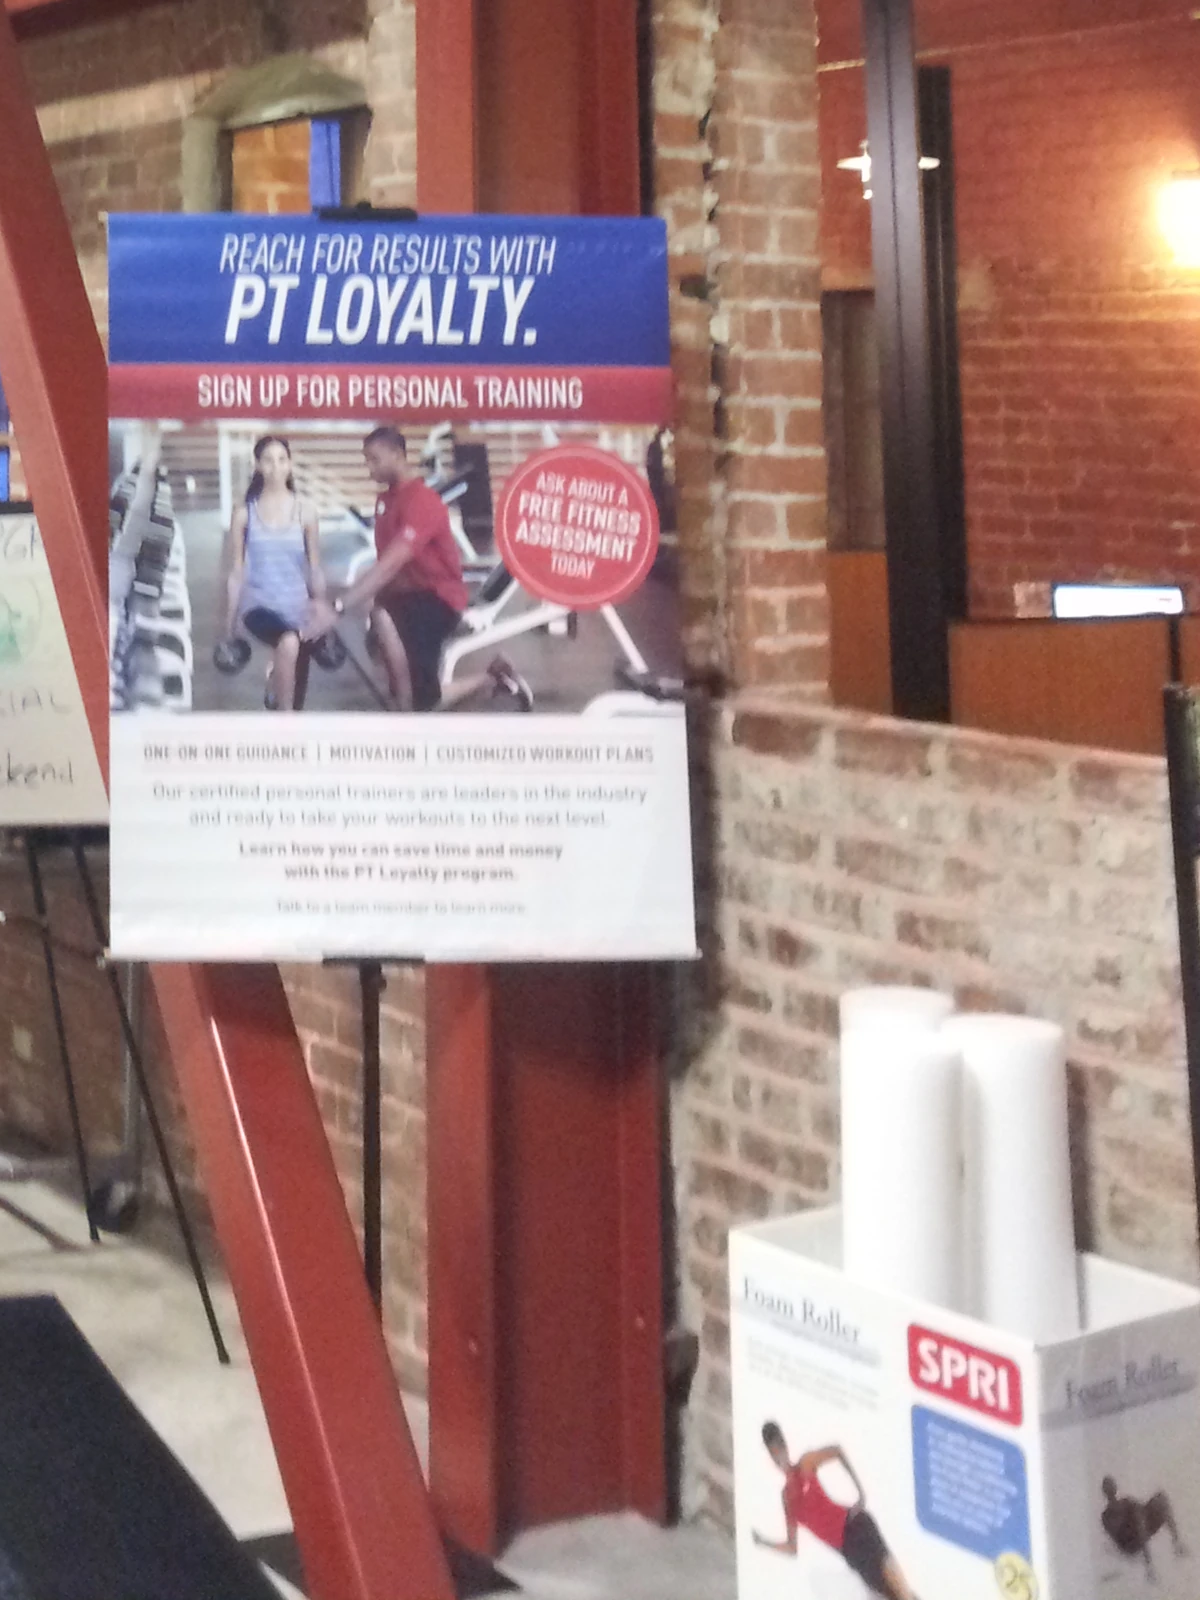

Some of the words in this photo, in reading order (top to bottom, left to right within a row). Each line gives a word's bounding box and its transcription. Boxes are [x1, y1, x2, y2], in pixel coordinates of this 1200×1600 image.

[219, 232, 305, 274] REACH
[311, 233, 365, 274] FOR
[370, 234, 484, 275] RESULTS
[489, 235, 557, 275] WITH
[224, 273, 300, 345] PT
[305, 274, 538, 347] LOYALTY.
[198, 374, 252, 408] SIGN
[259, 375, 288, 408] UP
[297, 375, 340, 408] FOR
[348, 375, 469, 409] PERSONAL
[474, 376, 583, 410] TRAINING
[536, 471, 565, 494] ASK
[568, 476, 615, 503] ABOUT
[618, 486, 628, 507] A
[518, 490, 564, 522] FREE
[567, 499, 641, 537] FITNESS
[515, 517, 637, 562] ASSESSMENT
[551, 552, 595, 580] TODAY
[237, 744, 308, 761] GUIDANCE
[329, 744, 416, 762] MOTIVATION
[436, 746, 526, 763] CUSTOMIZED
[530, 746, 601, 763] WORKOUT
[606, 747, 654, 764] PLANS
[152, 781, 183, 800] Our
[190, 780, 261, 800] certified
[266, 783, 341, 805] personal
[347, 782, 415, 801] trainers
[421, 789, 448, 802] are
[454, 784, 518, 802] leaders
[523, 785, 538, 802] in
[543, 785, 571, 802] the
[576, 785, 648, 806] industry
[189, 808, 221, 827] and
[226, 808, 274, 830] ready
[279, 809, 296, 827] to
[301, 809, 336, 827] take
[341, 812, 379, 831] your
[385, 809, 465, 828] workouts
[470, 810, 486, 827] to
[492, 809, 520, 827] the
[525, 811, 560, 828] next
[239, 839, 287, 857] Learn
[291, 840, 325, 857] how
[328, 843, 357, 861] you
[361, 844, 390, 857] can
[394, 844, 430, 858] save
[434, 842, 471, 858] time
[476, 842, 505, 858] and
[509, 844, 563, 862] money
[284, 865, 319, 879] with
[324, 865, 350, 879] the
[354, 866, 373, 879] PT
[379, 866, 438, 884] Loyalty
[743, 1275, 795, 1321] Foam
[801, 1297, 860, 1344] Roller
[916, 1337, 1010, 1411] SPRI
